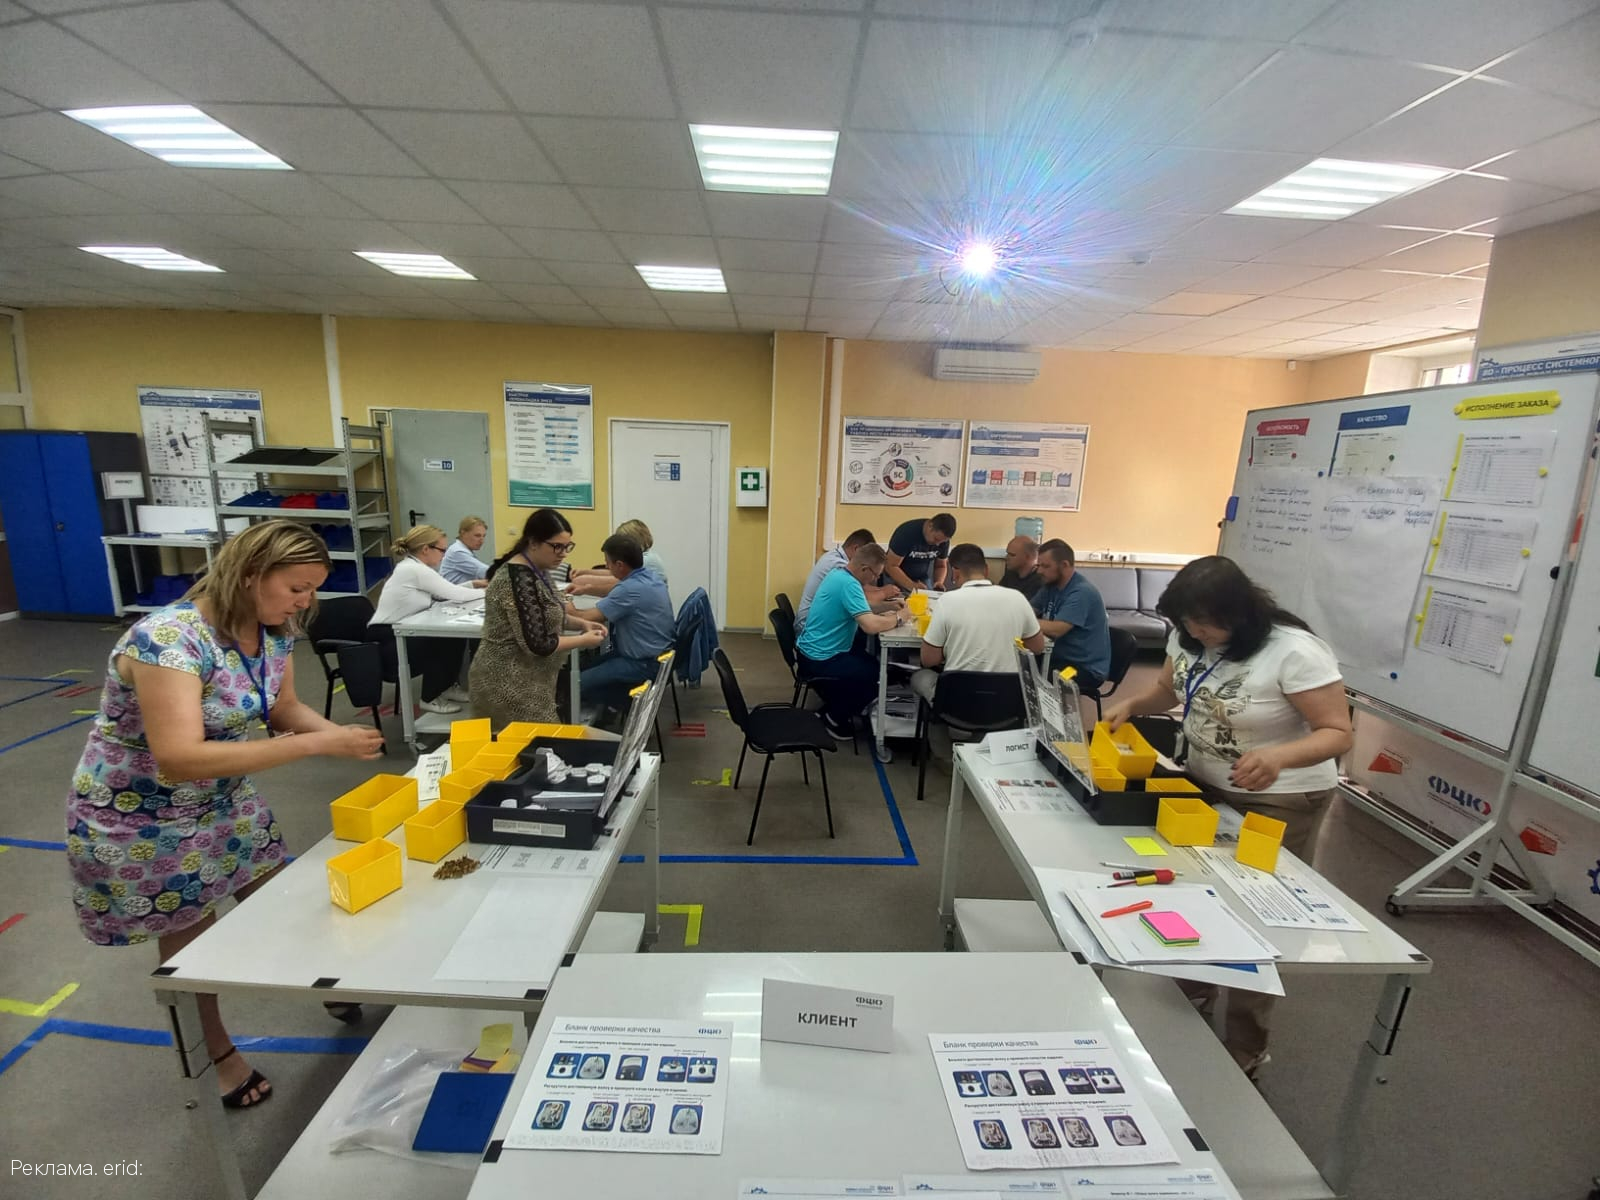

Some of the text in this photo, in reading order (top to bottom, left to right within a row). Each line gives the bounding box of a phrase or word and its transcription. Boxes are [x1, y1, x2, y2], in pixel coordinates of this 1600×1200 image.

[1501, 362, 1544, 375] ПРОЦЕСС
[1465, 399, 1549, 412] ИСПОЛНЕНИЕ ЗАКАЗА
[1357, 414, 1388, 424] КАЧЕСТВО
[798, 1012, 858, 1028] КЛИЕНТ
[564, 1023, 662, 1034] Бланк проверки качества
[943, 1039, 1039, 1050] Бланк проверки качества
